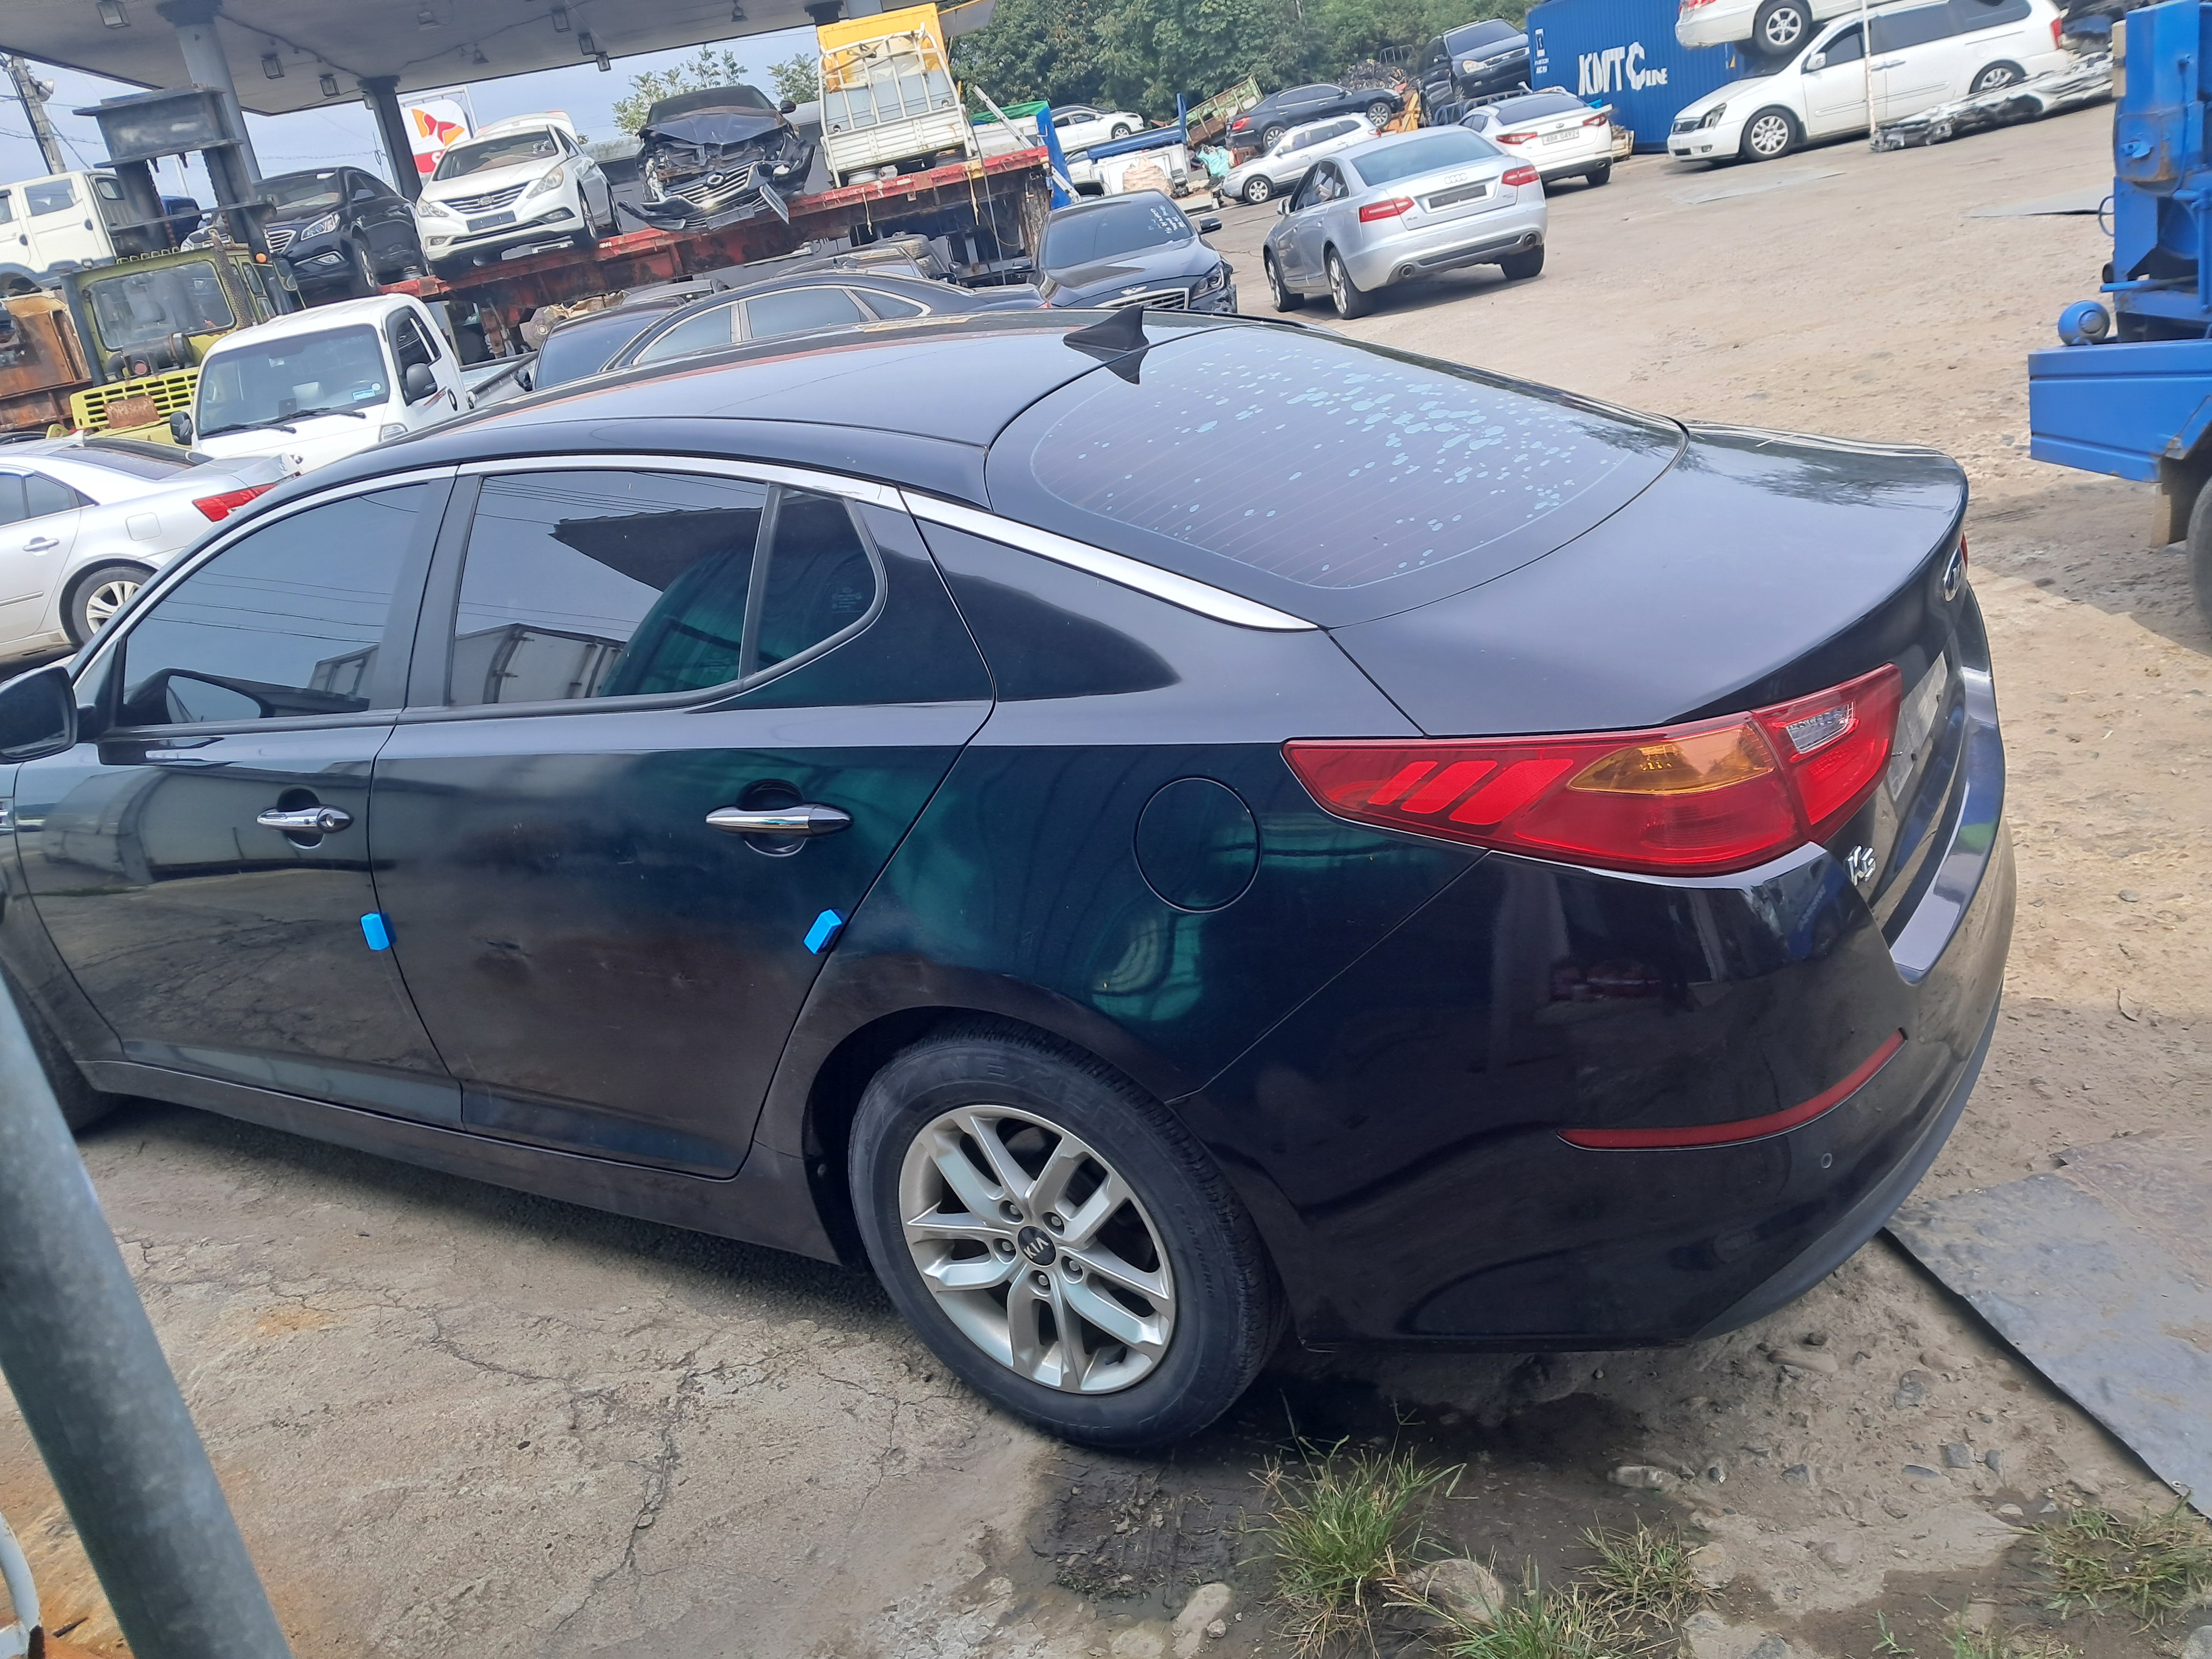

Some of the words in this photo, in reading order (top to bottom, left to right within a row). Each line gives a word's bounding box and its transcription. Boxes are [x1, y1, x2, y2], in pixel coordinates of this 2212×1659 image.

[1578, 41, 1646, 96] KMTC
[1645, 67, 1668, 86] LINE
[1023, 1237, 1050, 1259] KIA
